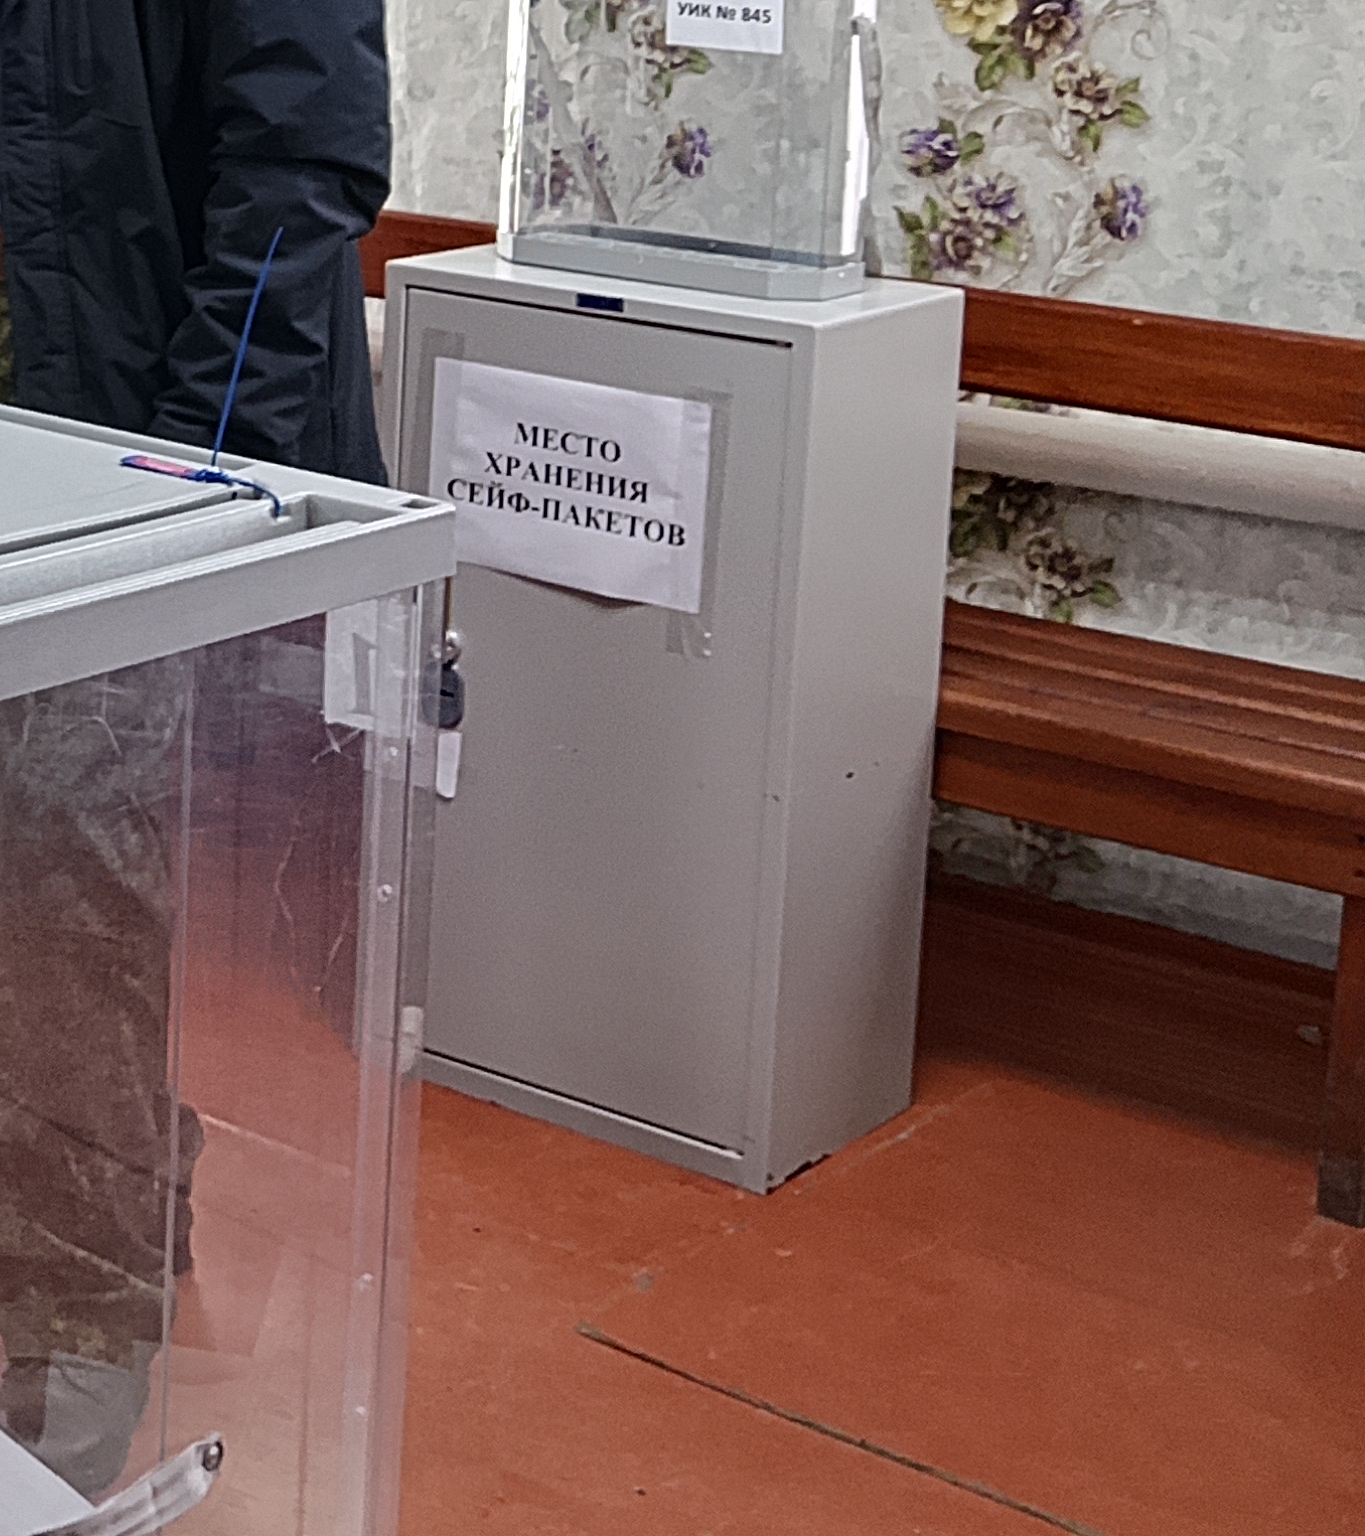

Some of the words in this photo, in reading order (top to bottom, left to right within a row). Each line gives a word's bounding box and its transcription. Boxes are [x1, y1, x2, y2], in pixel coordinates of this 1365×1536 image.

[677, 2, 712, 18] УИК
[716, 5, 736, 21] №
[741, 7, 771, 24] 845
[514, 422, 621, 463] МЕСТО
[484, 452, 648, 504] ХРАНЕНИЯ
[446, 478, 687, 547] СЕЙФ-ПАКЕТОВ
